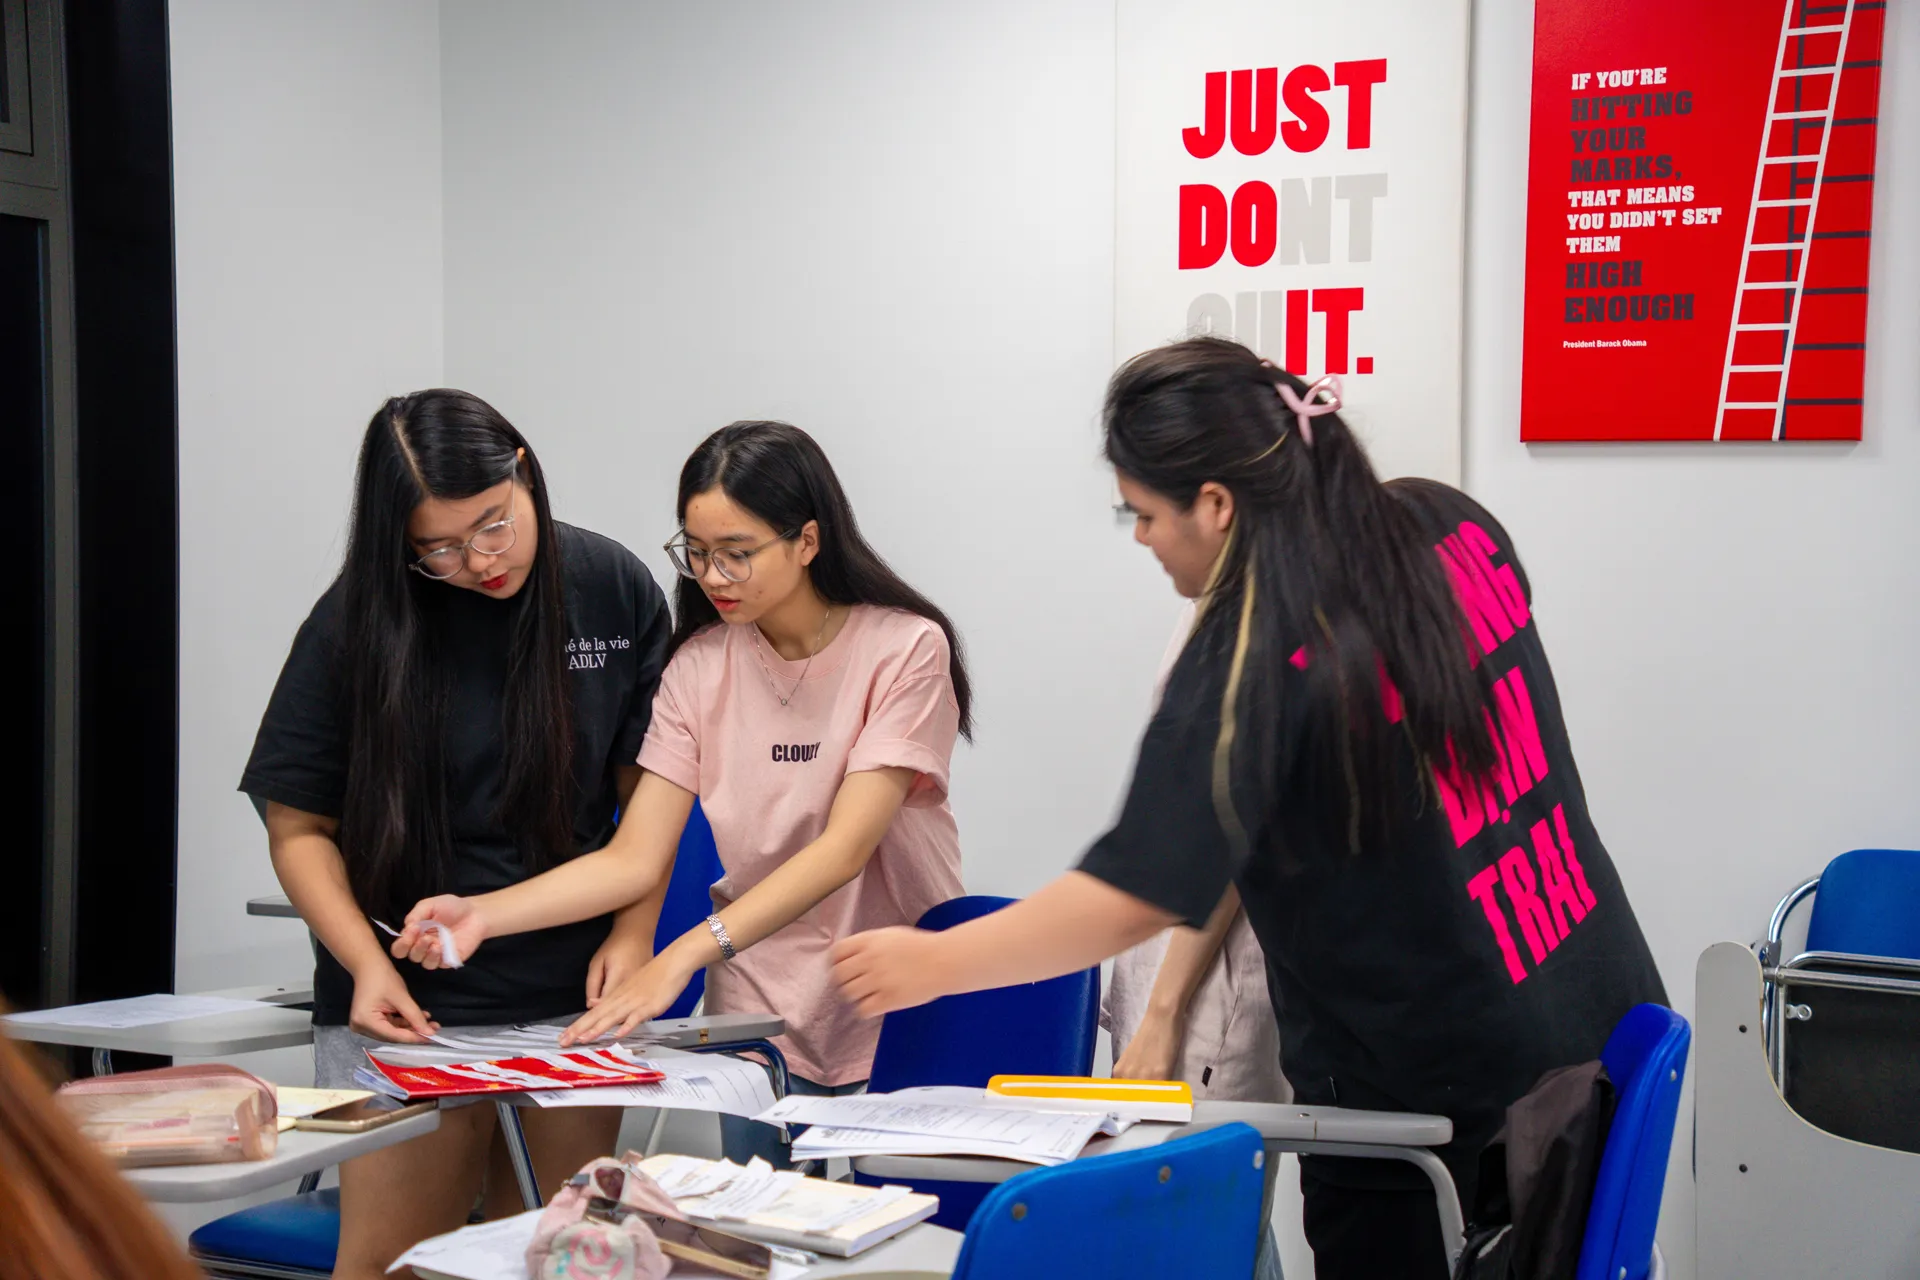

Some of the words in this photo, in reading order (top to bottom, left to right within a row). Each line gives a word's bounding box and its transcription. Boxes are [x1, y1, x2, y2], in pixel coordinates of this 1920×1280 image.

[1571, 73, 1592, 91] IF
[1596, 67, 1668, 89] YOU'RE
[1181, 58, 1388, 160] JUST
[1570, 89, 1693, 122] HITTING
[1570, 126, 1647, 153] YOUR
[1569, 154, 1682, 183] MARKS,
[1567, 189, 1621, 208] THAT
[1626, 185, 1695, 205] MEANS
[1178, 172, 1389, 271] DONT
[1566, 213, 1605, 230] YOU
[1609, 209, 1677, 229] DIDN'T
[1681, 207, 1723, 225] SET
[1565, 235, 1621, 254] THEM
[1565, 260, 1643, 289] HIGH
[1564, 293, 1695, 324] ENOUGH
[1563, 340, 1596, 349] President
[1596, 339, 1622, 348] Barack
[1622, 338, 1648, 348] Obama
[579, 637, 592, 652] de
[594, 637, 607, 651] la
[609, 635, 630, 649] vie
[568, 653, 607, 670] ADLV
[1466, 803, 1598, 985] TRAI
